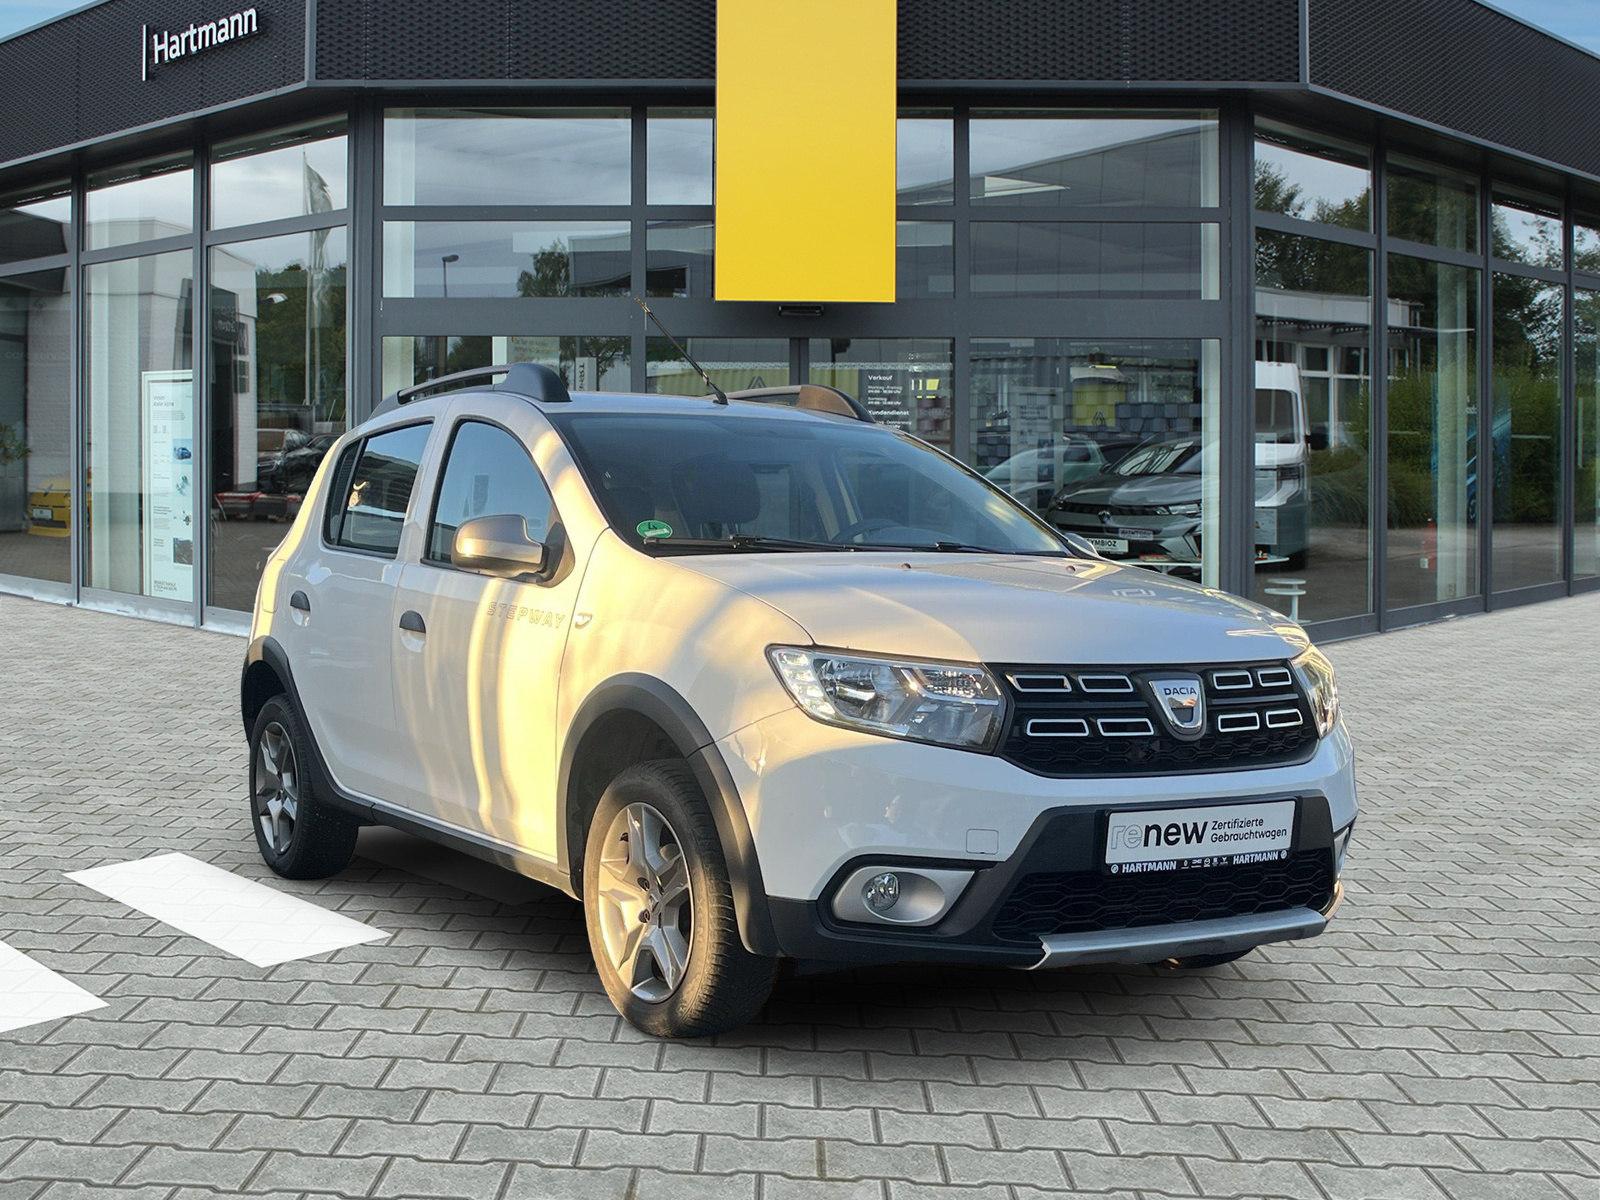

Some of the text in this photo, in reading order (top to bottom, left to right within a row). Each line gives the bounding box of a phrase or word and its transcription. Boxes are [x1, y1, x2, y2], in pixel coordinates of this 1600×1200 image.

[153, 8, 258, 64] Hartmann
[487, 601, 566, 628] STEPWAY
[1163, 687, 1197, 696] DACIA
[1211, 818, 1264, 831] Zertifizierte
[1110, 821, 1208, 850] renew
[1210, 828, 1288, 844] Gebrauchtwagen
[1232, 851, 1278, 865] HARTMANN
[1121, 860, 1177, 874] HARTMANN
